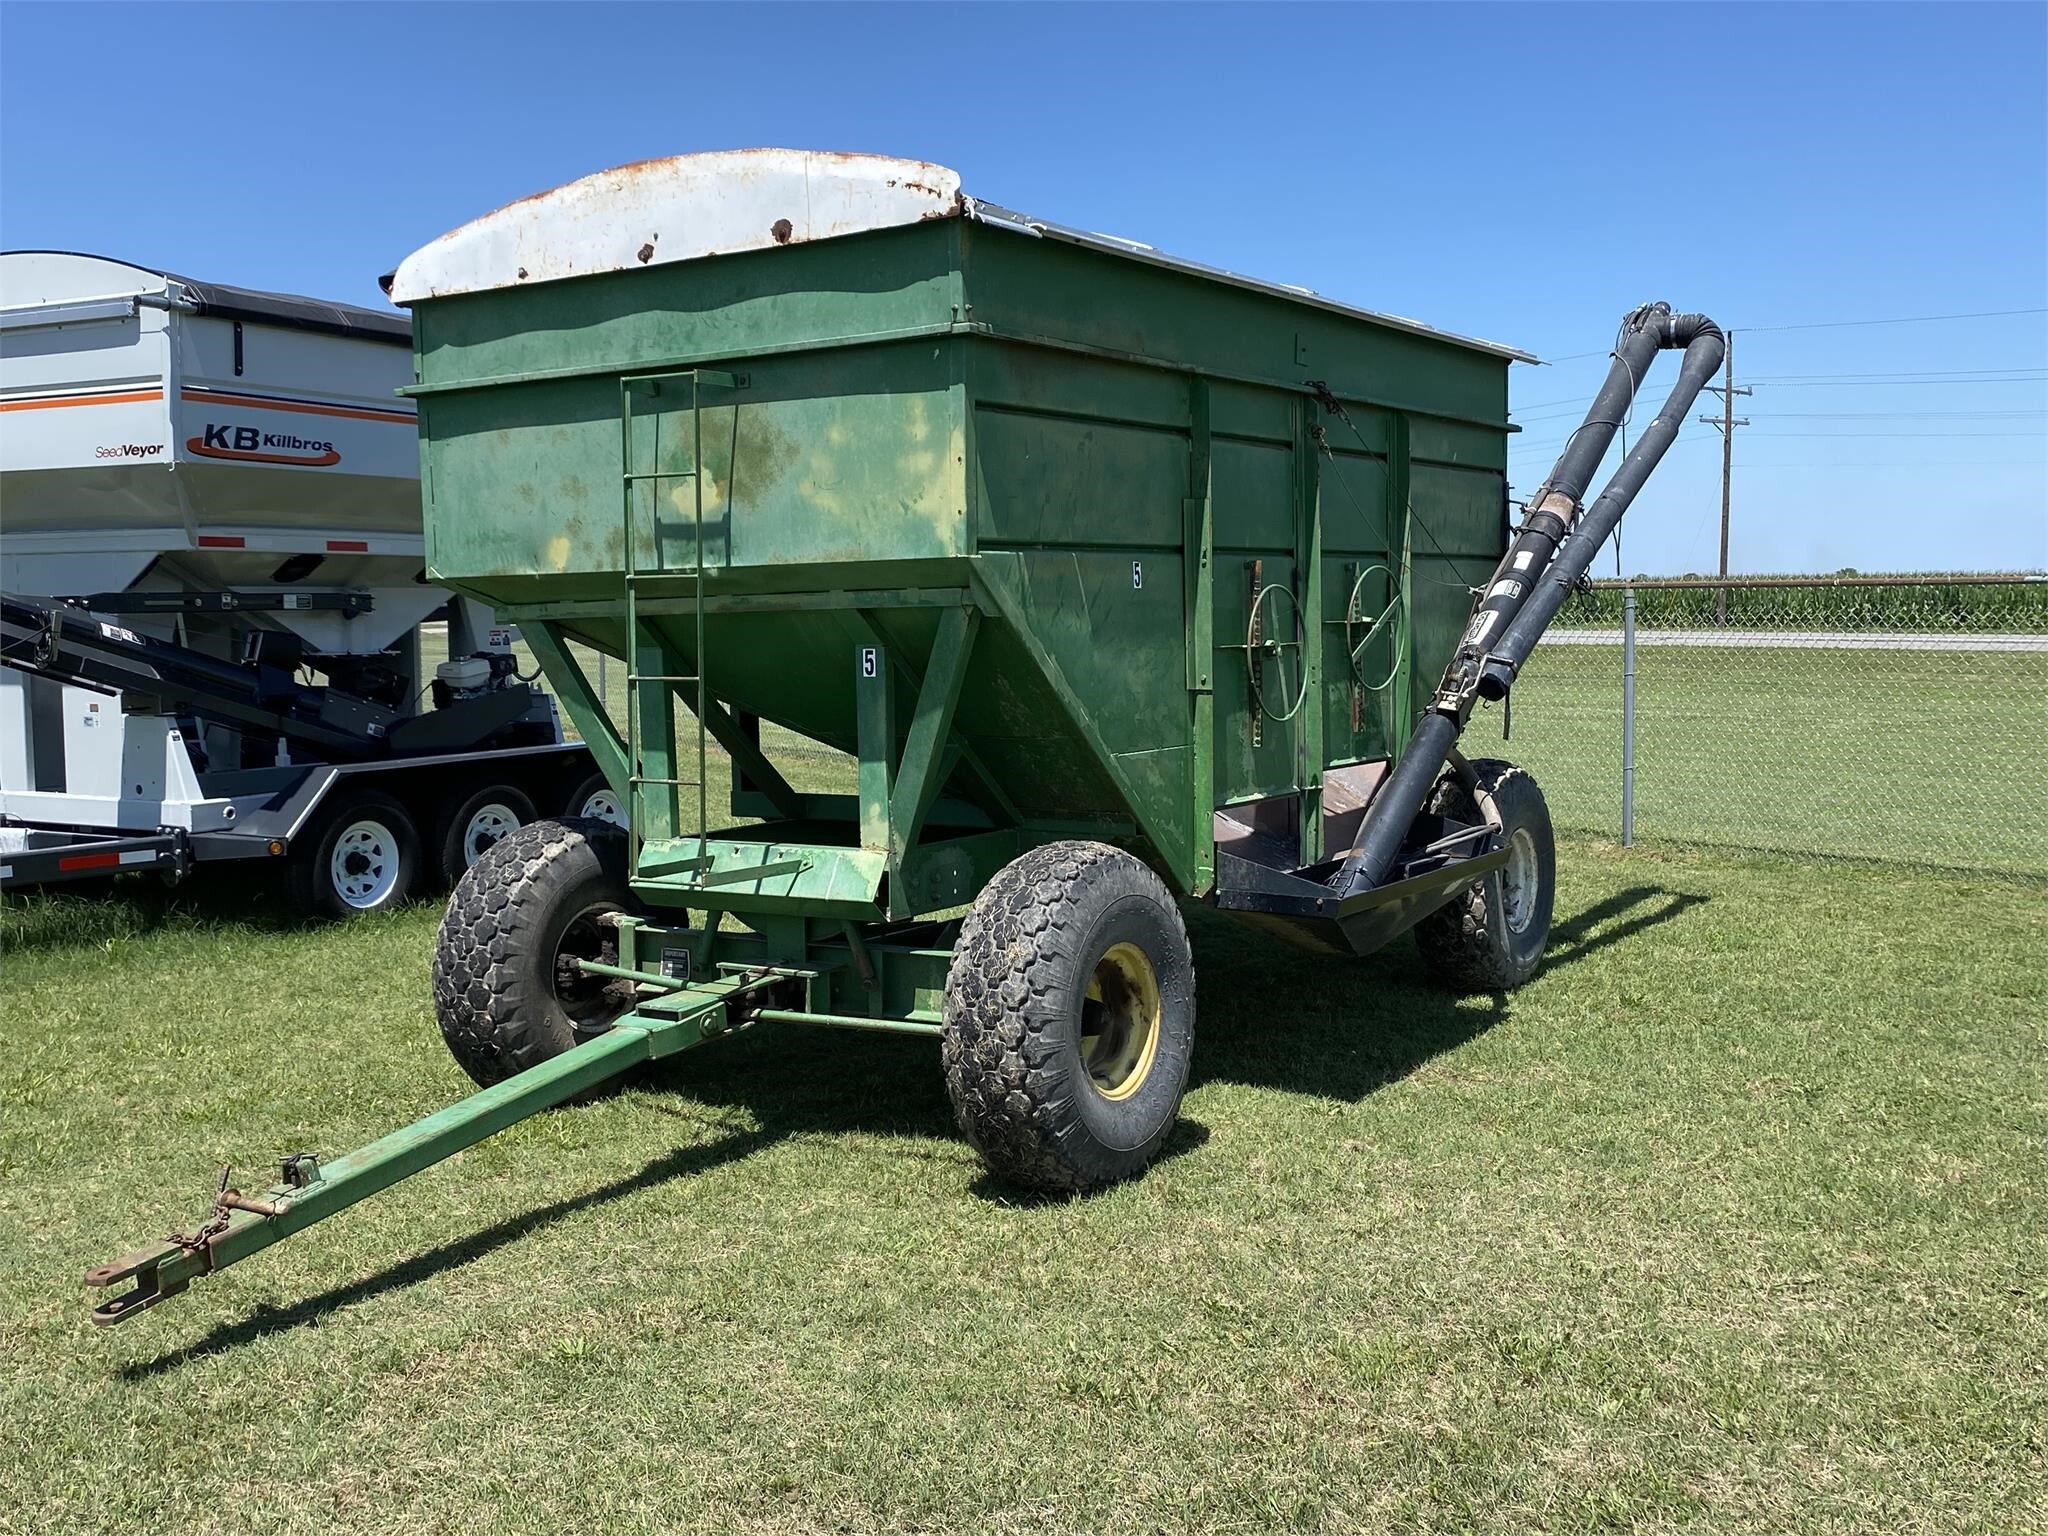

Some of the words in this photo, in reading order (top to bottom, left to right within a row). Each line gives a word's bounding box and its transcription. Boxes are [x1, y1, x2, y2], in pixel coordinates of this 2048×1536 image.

[203, 424, 260, 451] KB
[263, 433, 333, 452] Killbros
[1134, 562, 1141, 588] 5
[864, 650, 874, 676] 5
